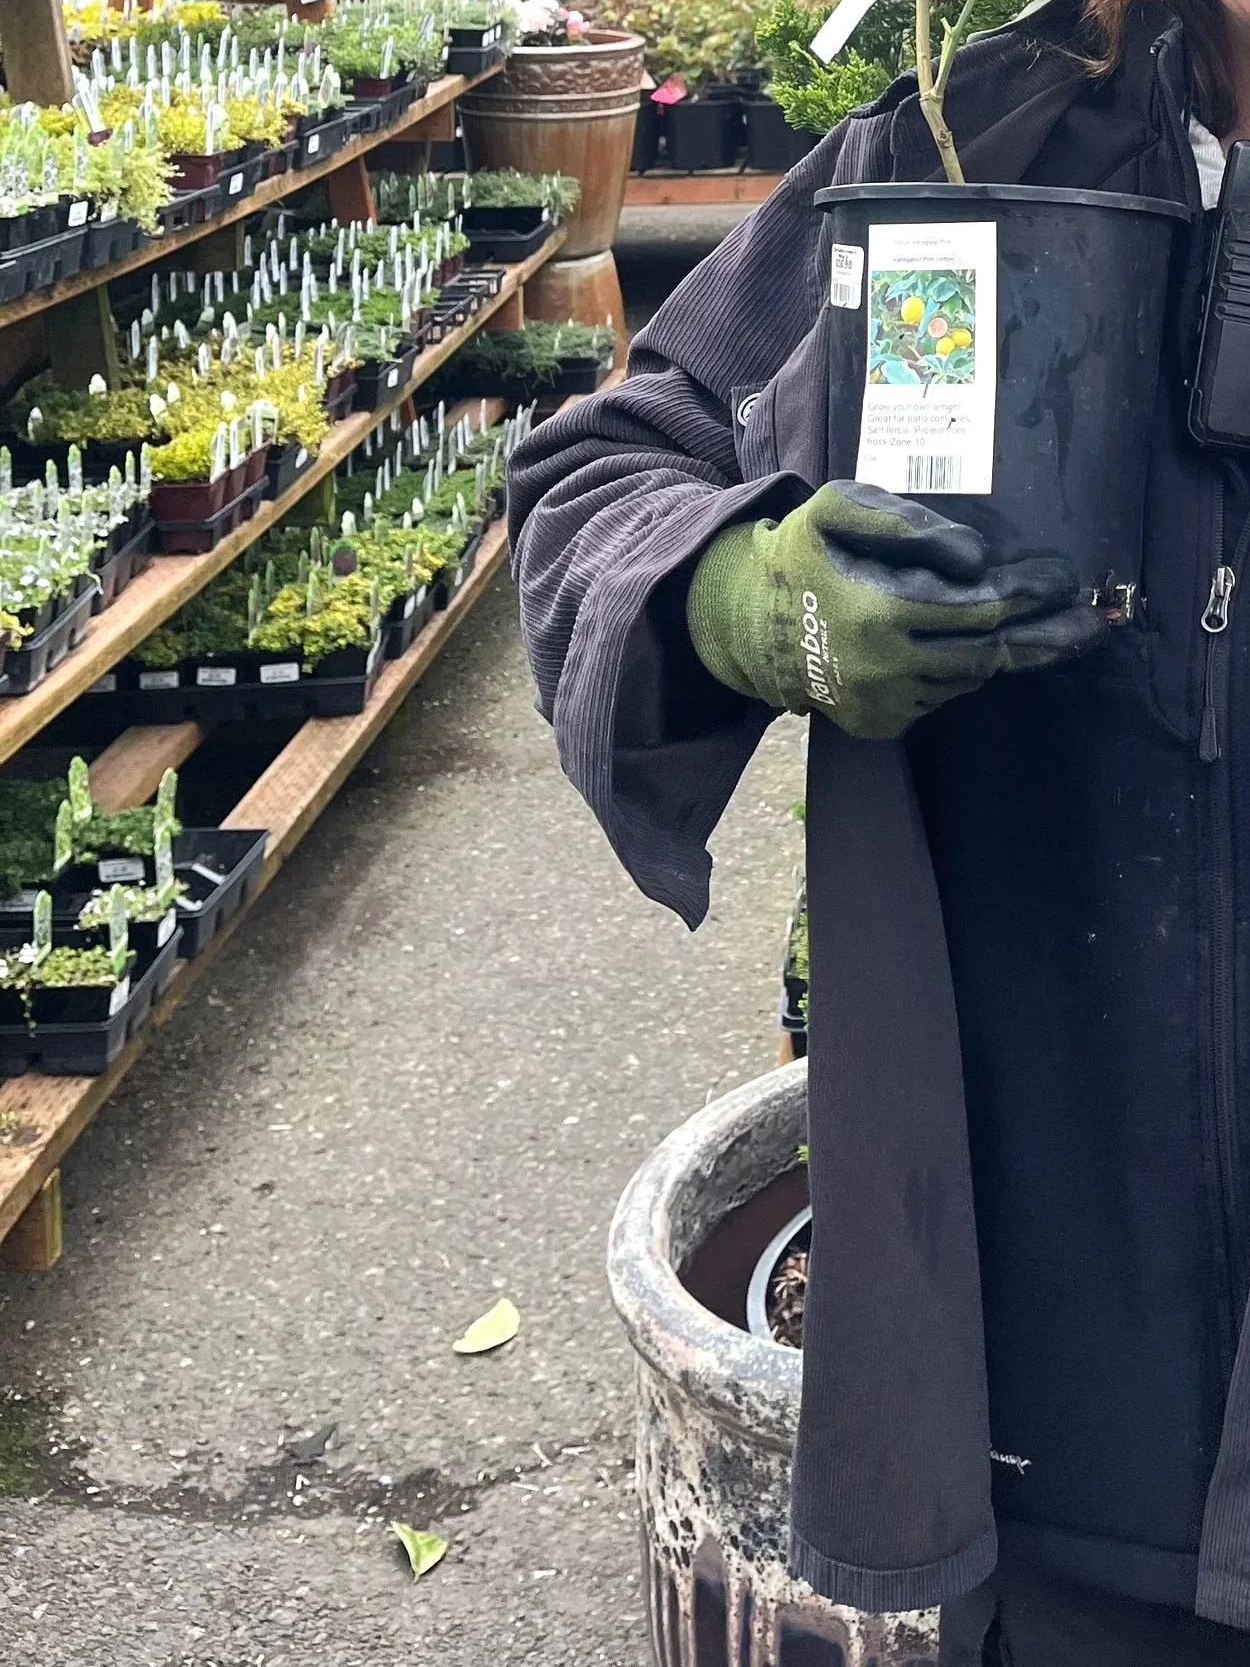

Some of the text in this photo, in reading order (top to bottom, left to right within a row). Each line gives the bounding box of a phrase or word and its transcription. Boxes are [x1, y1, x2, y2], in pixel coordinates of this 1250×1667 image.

[867, 402, 961, 413] Grow your own lemon!
[867, 414, 891, 423] Great
[893, 414, 905, 423] for
[907, 415, 928, 424] patio
[914, 425, 944, 435] Protect
[946, 426, 966, 435] from
[890, 437, 912, 447] Zone
[915, 437, 926, 447] 10
[801, 590, 836, 706] bamboo
